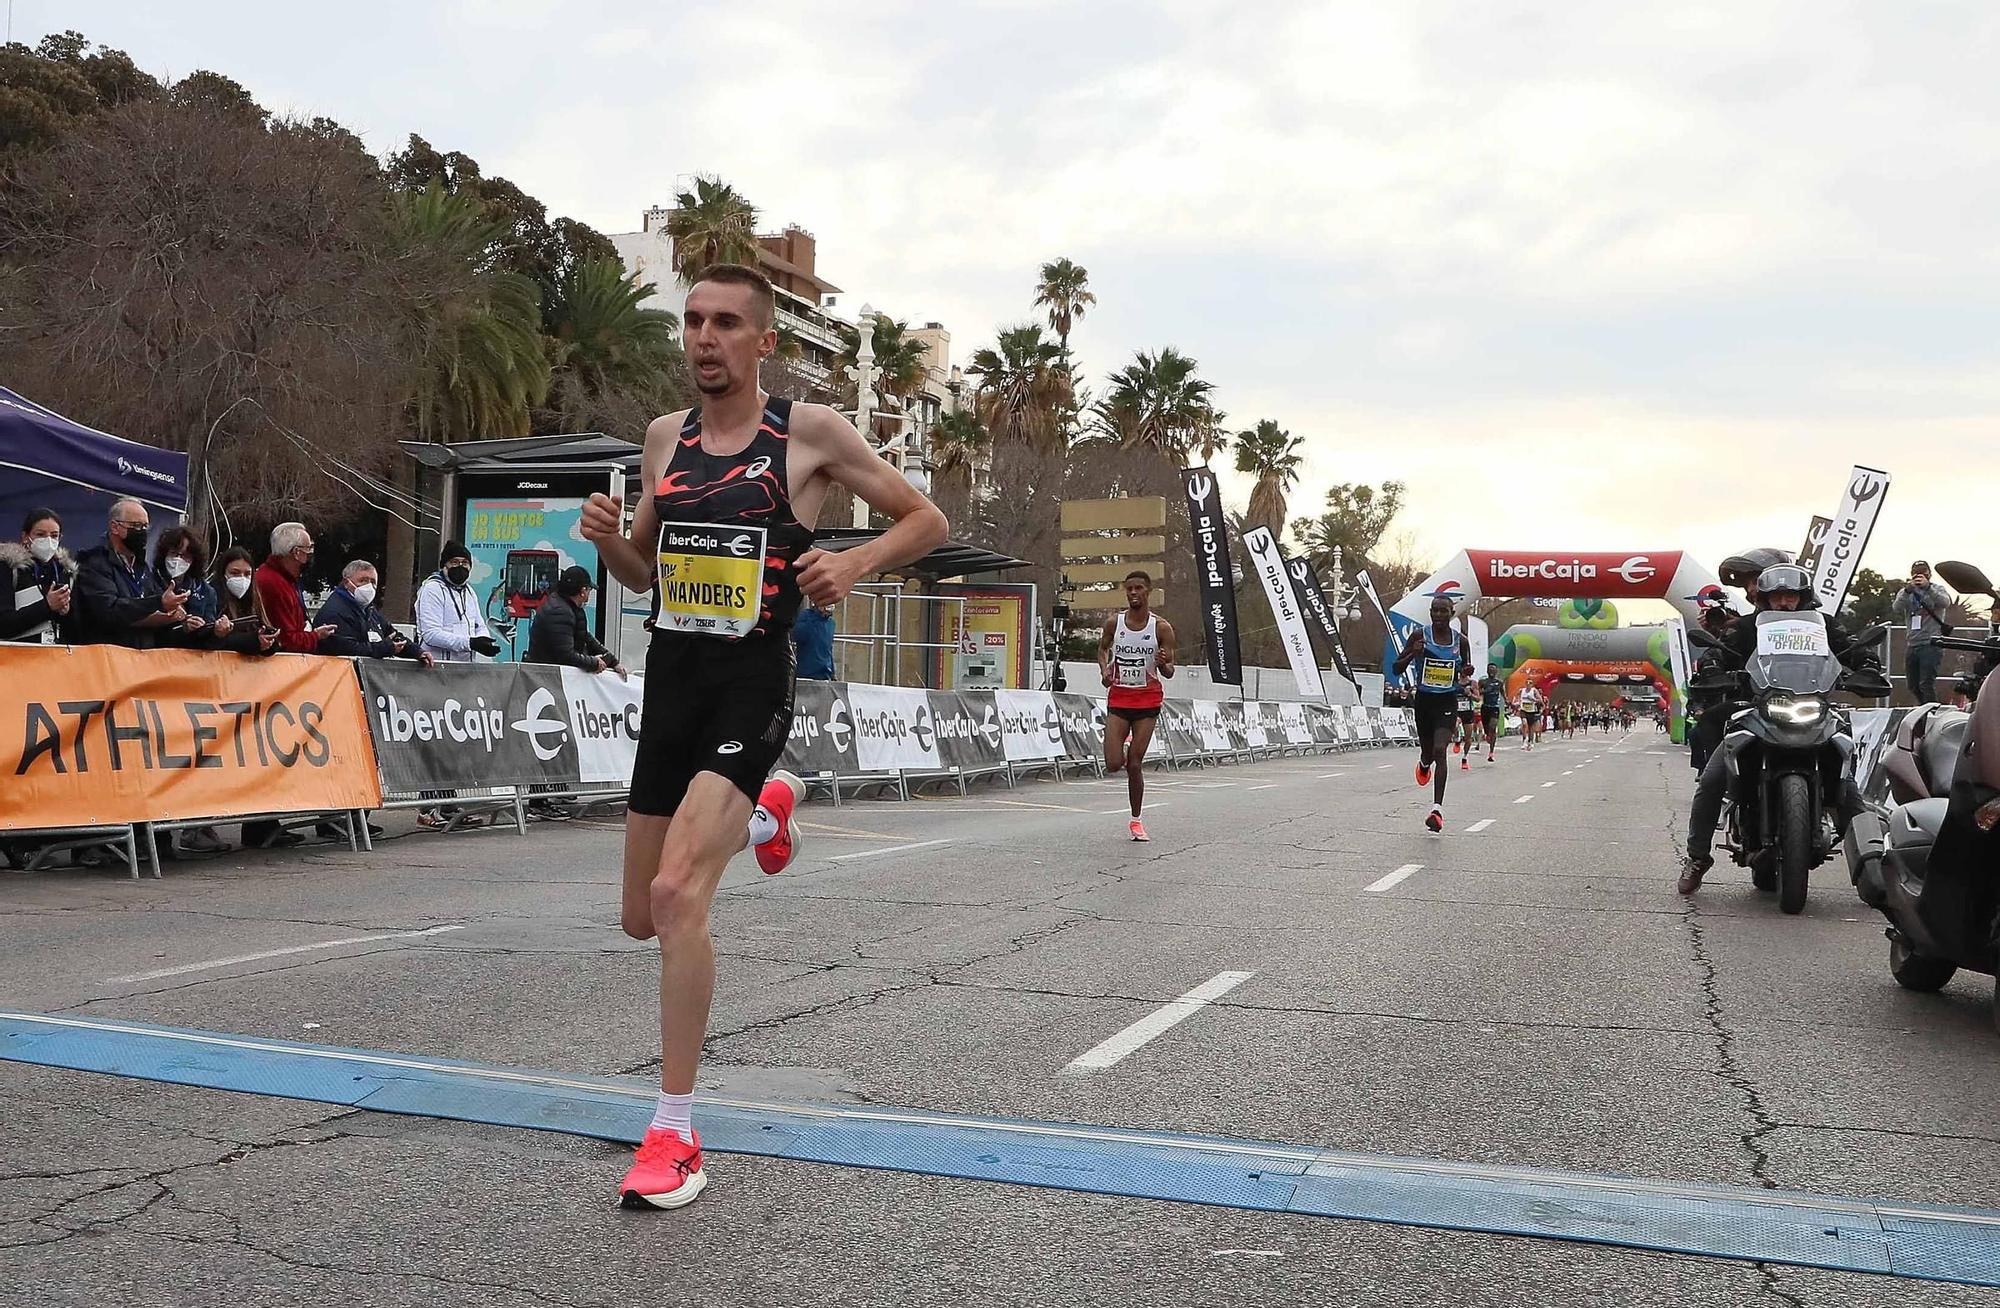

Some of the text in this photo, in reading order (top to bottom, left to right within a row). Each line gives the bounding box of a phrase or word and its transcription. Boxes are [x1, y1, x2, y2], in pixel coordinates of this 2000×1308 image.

[669, 533, 718, 550] iberCaja
[1489, 558, 1597, 583] iberCaja
[667, 580, 747, 608] WANDERS
[951, 630, 971, 641] BA
[1569, 633, 1607, 641] TRINIDAD
[1115, 645, 1154, 655] ENGLAND
[1568, 641, 1607, 649] ALFONSO
[1775, 641, 1817, 651] OFICIAL
[1122, 669, 1141, 677] 2147
[376, 694, 504, 753] iberCaja
[855, 706, 906, 746] iberCaja
[935, 708, 979, 744] iberCaja
[15, 700, 330, 775] ATHLETICS
